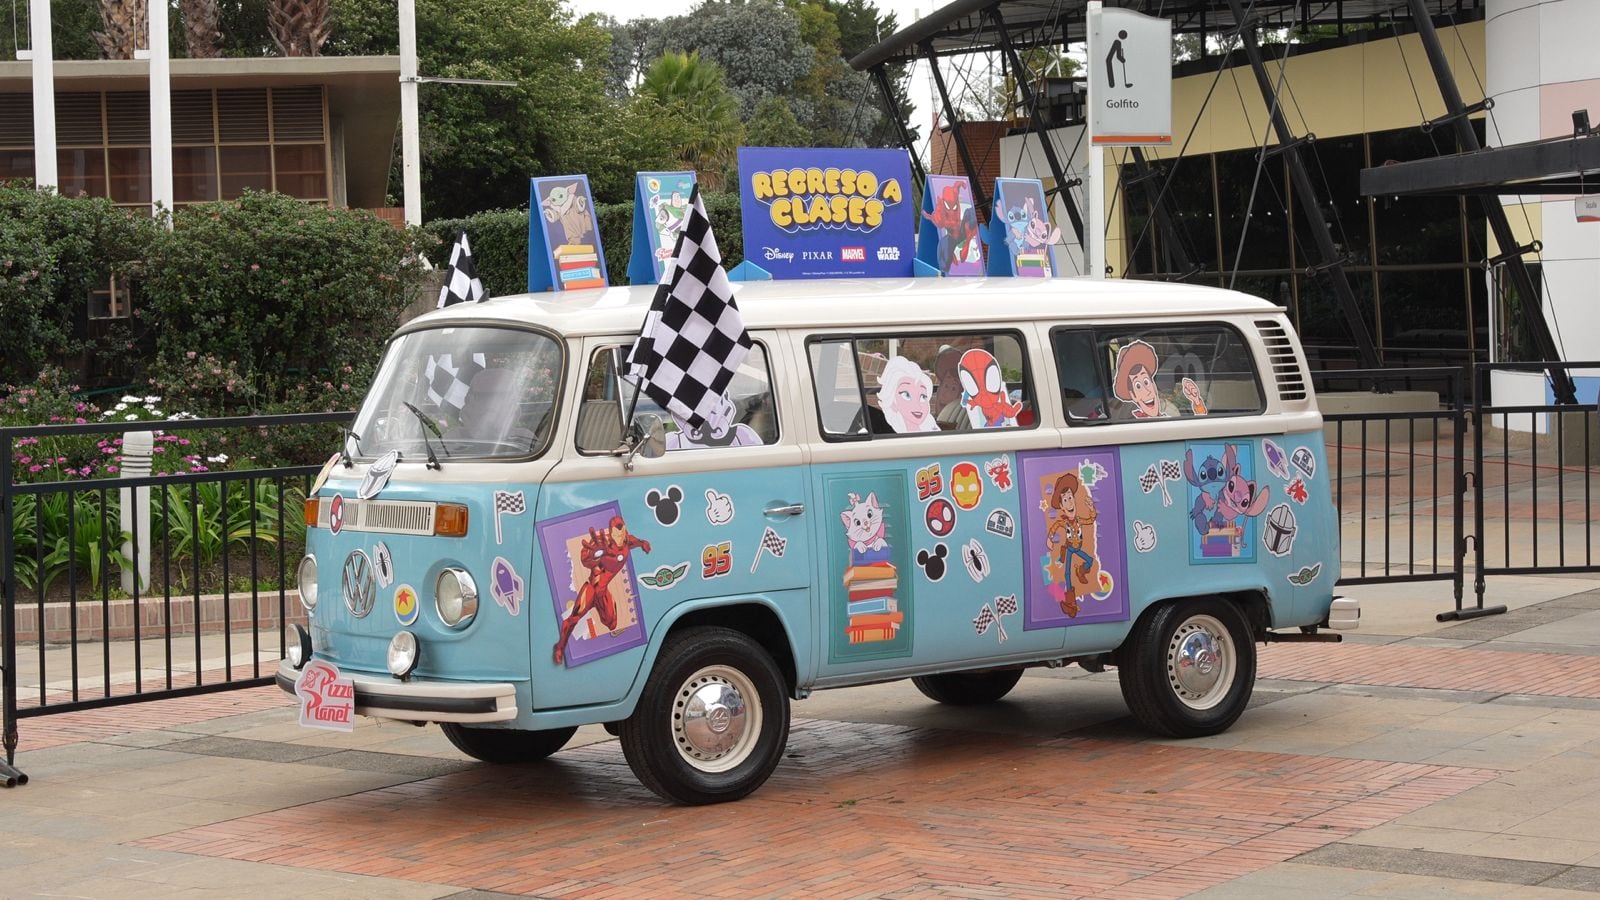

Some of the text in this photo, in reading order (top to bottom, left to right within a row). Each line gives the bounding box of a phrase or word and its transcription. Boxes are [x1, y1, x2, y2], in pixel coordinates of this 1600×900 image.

[1106, 99, 1139, 109] Golfito
[752, 168, 903, 203] REGRESO A
[770, 194, 885, 227] CLASES
[802, 251, 833, 260] PIXAR
[841, 248, 865, 260] MARVEL
[877, 246, 900, 254] STAR
[877, 252, 900, 261] WARS
[915, 464, 943, 501] 95
[703, 542, 731, 578] 95
[316, 665, 353, 699] Pizza
[301, 689, 353, 723] Planet
